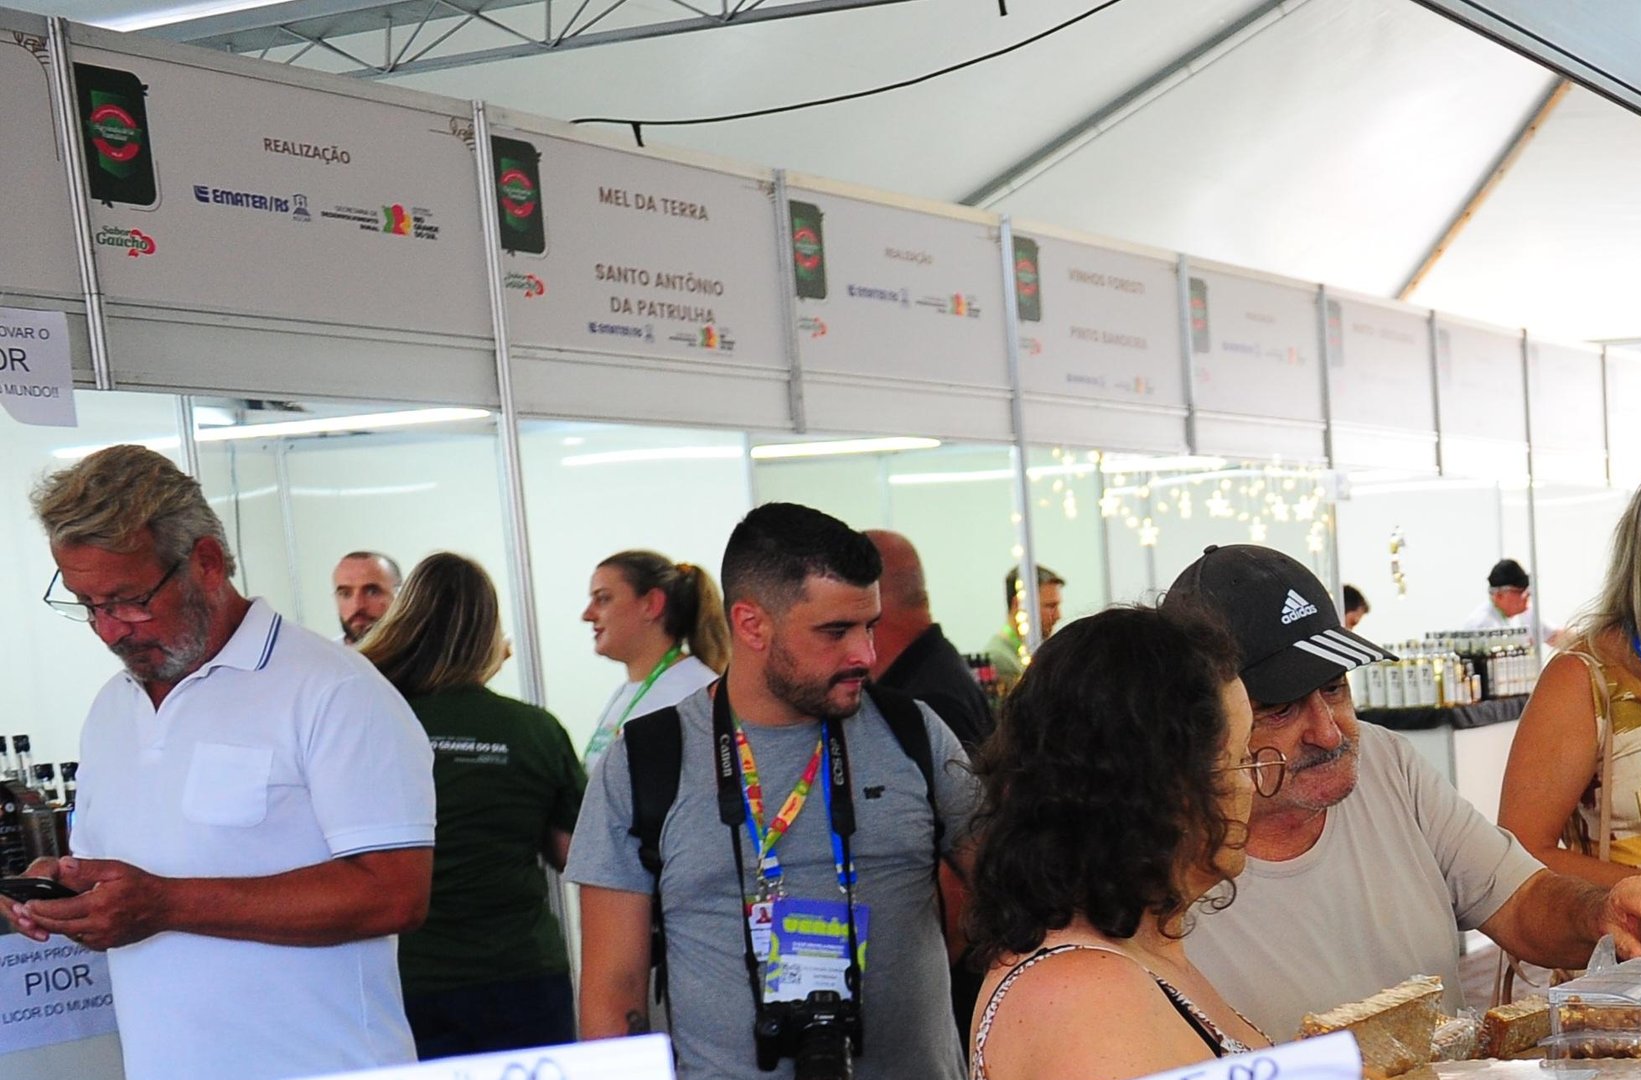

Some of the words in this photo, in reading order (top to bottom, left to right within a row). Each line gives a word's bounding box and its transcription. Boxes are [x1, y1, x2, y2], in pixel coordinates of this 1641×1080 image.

[264, 138, 350, 165] REALIZAÇÃO
[212, 189, 289, 212] EMATER/RS
[598, 187, 630, 208] MEL
[635, 194, 657, 212] DA
[661, 198, 709, 221] TERRA
[102, 225, 131, 237] Sabor
[595, 263, 650, 286] SANTO
[610, 296, 633, 314] DA
[637, 300, 716, 324] PATRULHA
[39, 328, 50, 340] O
[1281, 604, 1317, 624] adidas
[719, 733, 733, 777] Canon
[25, 964, 94, 996] PIOR
[2, 1006, 41, 1025] LICOR
[44, 1003, 64, 1017] DO
